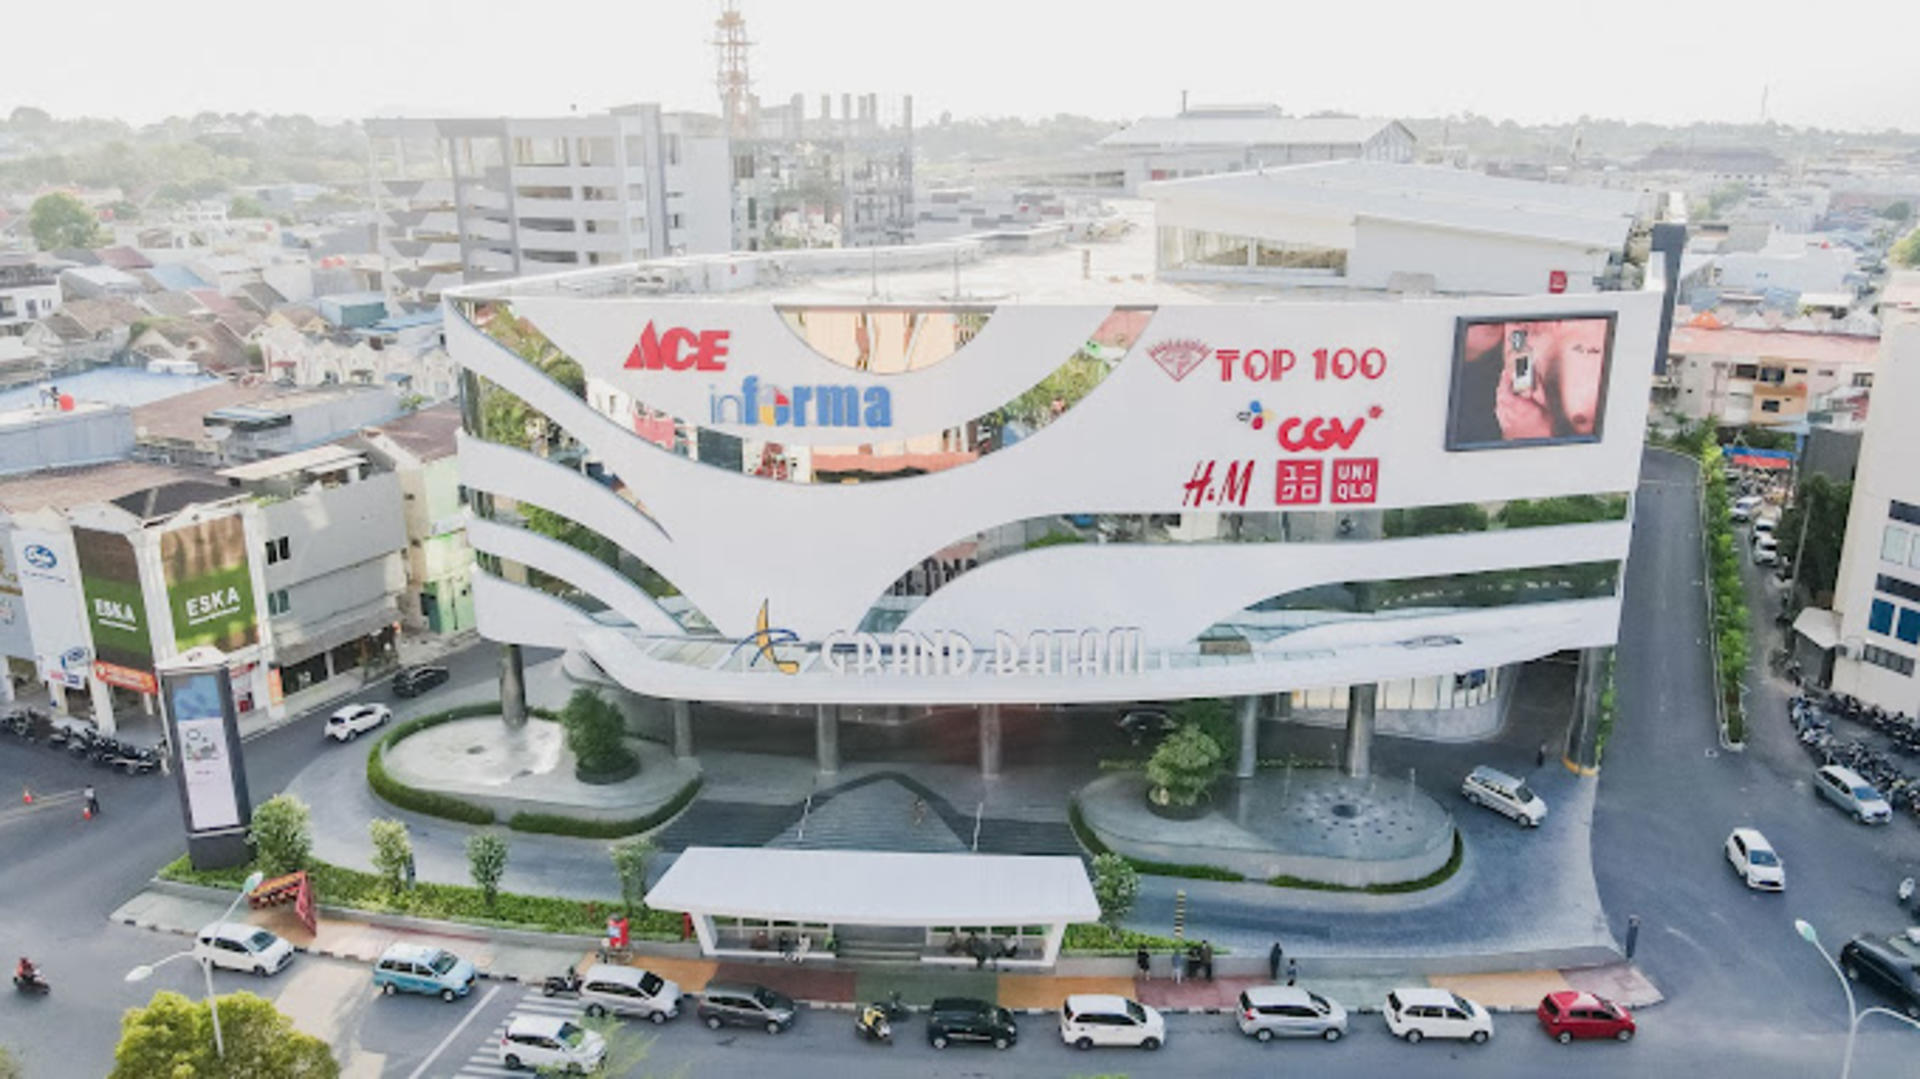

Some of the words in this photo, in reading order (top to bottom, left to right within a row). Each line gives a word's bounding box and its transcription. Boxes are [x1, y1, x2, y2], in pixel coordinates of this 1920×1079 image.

[623, 319, 731, 371] ACE
[1215, 349, 1297, 382] TOP
[1312, 348, 1387, 380] 100
[709, 375, 893, 428] informa
[1277, 416, 1366, 452] CGV
[1337, 464, 1372, 481] UNI
[1337, 483, 1373, 501] QLO
[93, 598, 136, 623] ESKA
[185, 587, 241, 617] ESKA
[821, 629, 973, 677] GRAND
[985, 626, 1146, 677] BATAM
